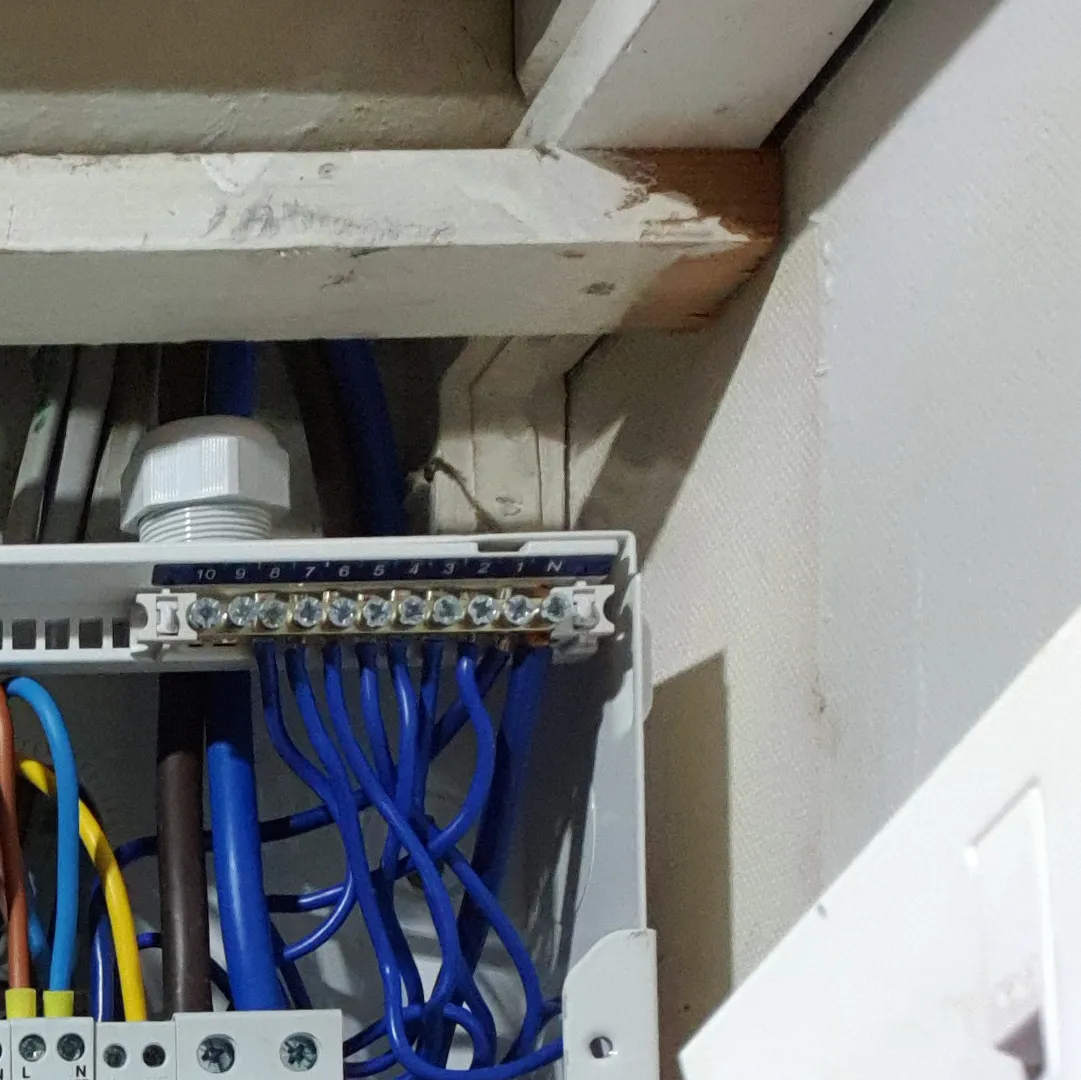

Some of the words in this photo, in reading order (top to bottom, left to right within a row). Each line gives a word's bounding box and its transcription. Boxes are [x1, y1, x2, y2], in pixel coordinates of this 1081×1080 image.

[196, 569, 216, 580] 10
[235, 568, 246, 580] 9
[269, 567, 281, 579] 8
[305, 566, 316, 578] 7
[338, 565, 350, 577] 6
[373, 564, 385, 576] 5
[407, 564, 419, 575] 4
[443, 563, 456, 574] 3
[477, 563, 490, 573] 2
[546, 561, 562, 572] N
[22, 1066, 30, 1079] L
[76, 1065, 87, 1077] N
